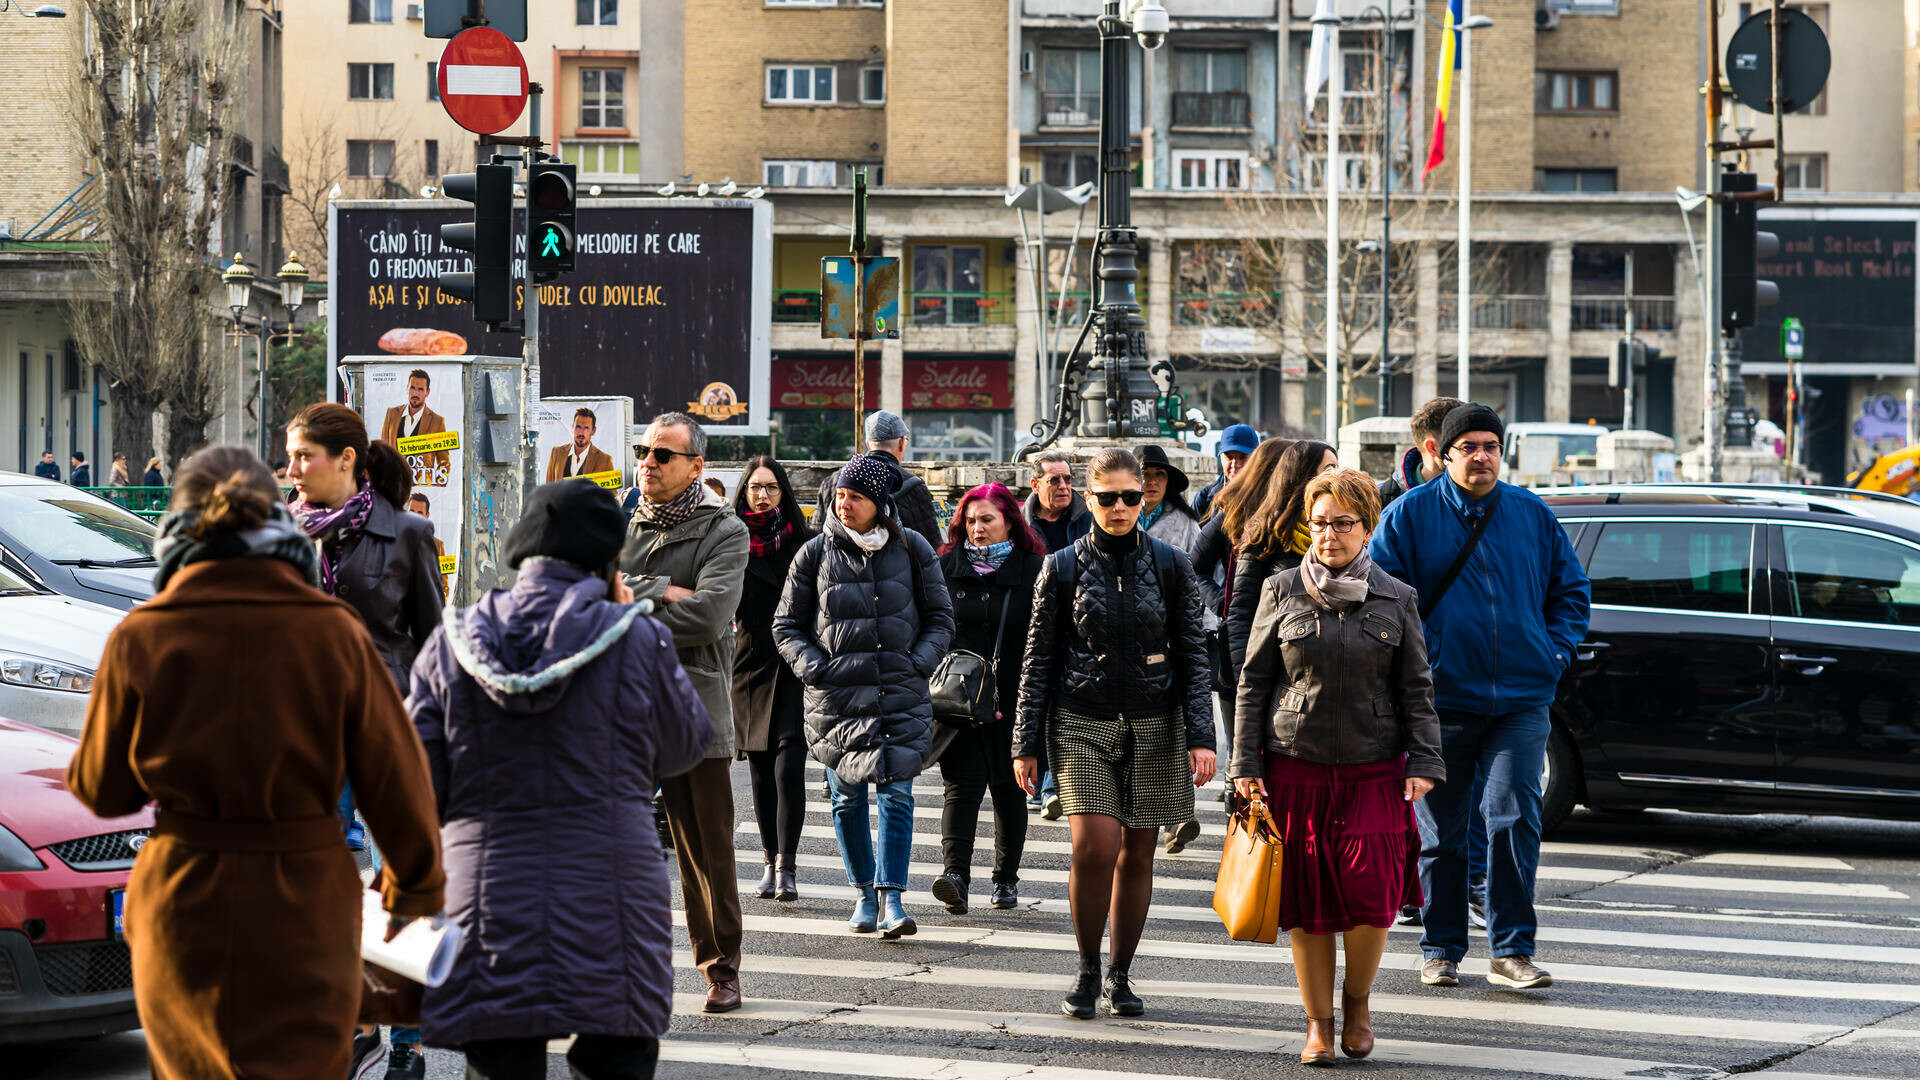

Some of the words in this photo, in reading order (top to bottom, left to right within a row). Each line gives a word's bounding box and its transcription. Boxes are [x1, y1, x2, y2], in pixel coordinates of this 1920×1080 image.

[369, 230, 408, 254] CÂND
[576, 233, 638, 254] MELODIEI
[644, 234, 661, 254] PE
[667, 233, 701, 254] CARE
[369, 258, 380, 279] O
[402, 286, 409, 306] E
[579, 286, 597, 306] CU
[603, 285, 668, 306] DOVLEAC.
[400, 445, 407, 453] 26
